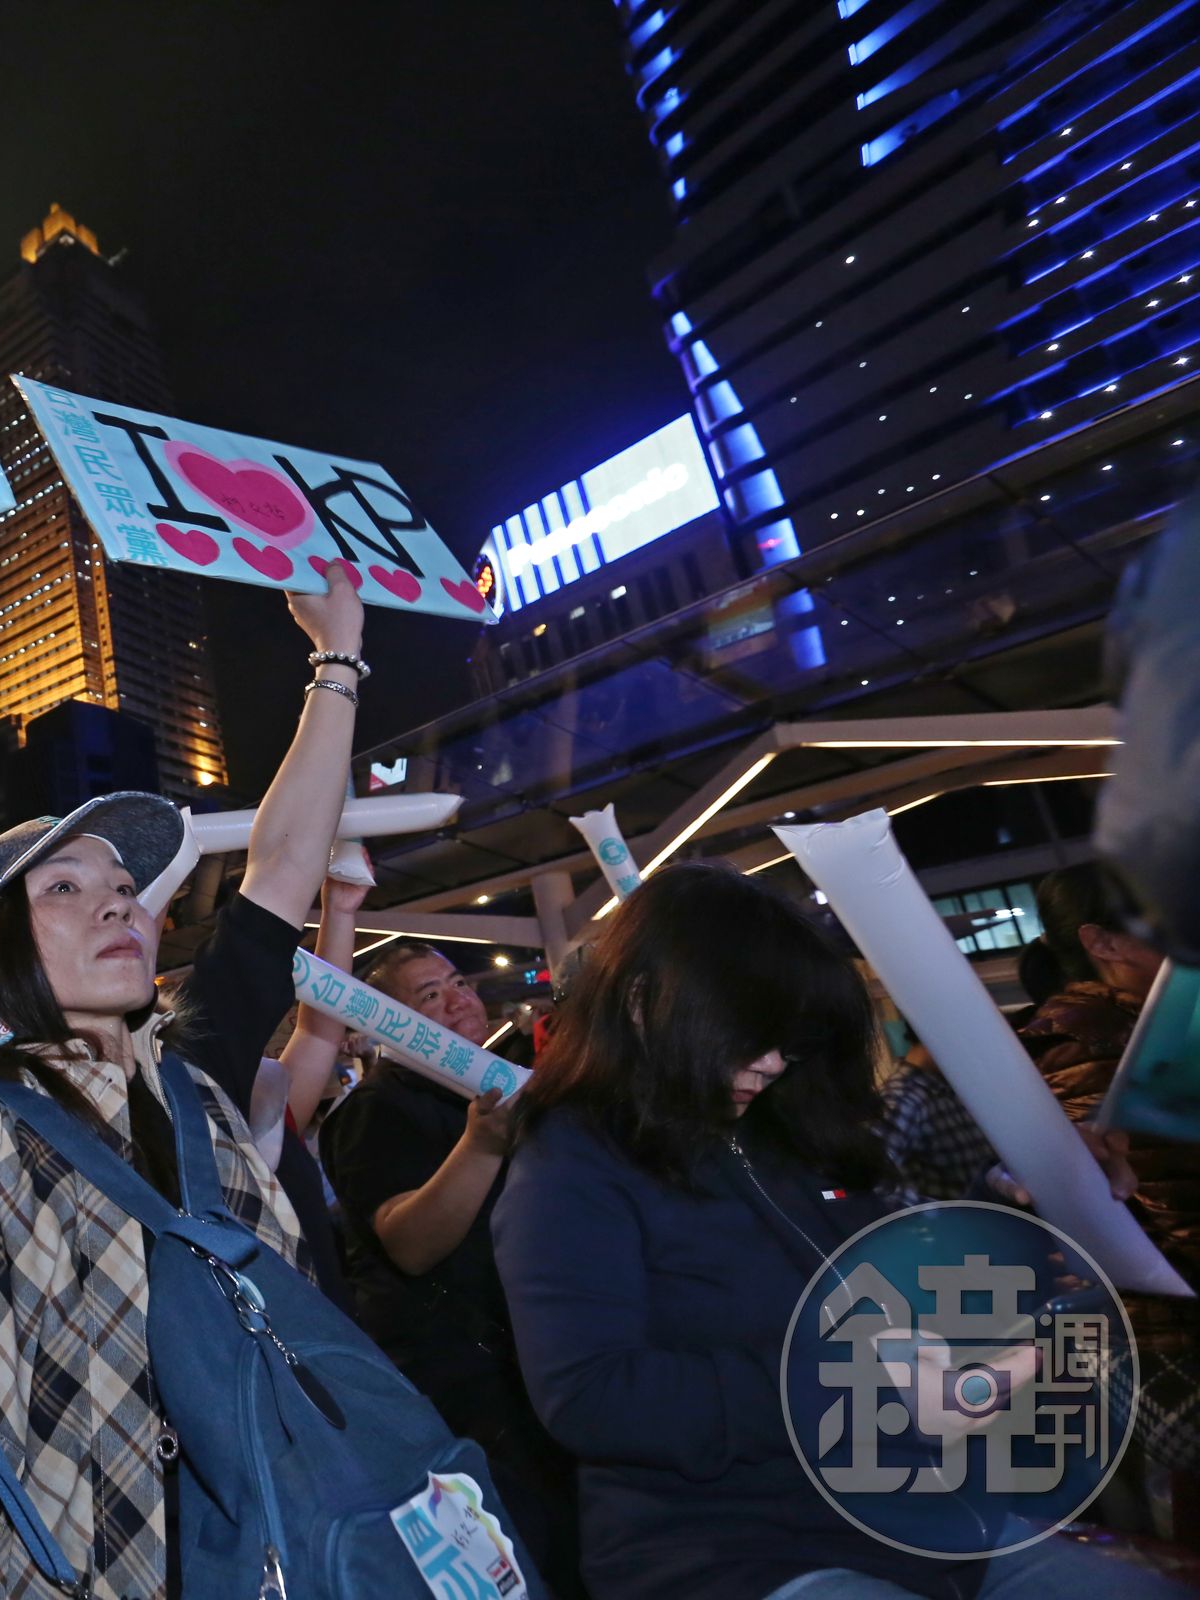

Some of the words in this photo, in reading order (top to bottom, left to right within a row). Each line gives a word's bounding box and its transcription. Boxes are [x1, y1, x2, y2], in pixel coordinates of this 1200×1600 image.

[310, 972, 475, 1077] 台灣民眾黨
